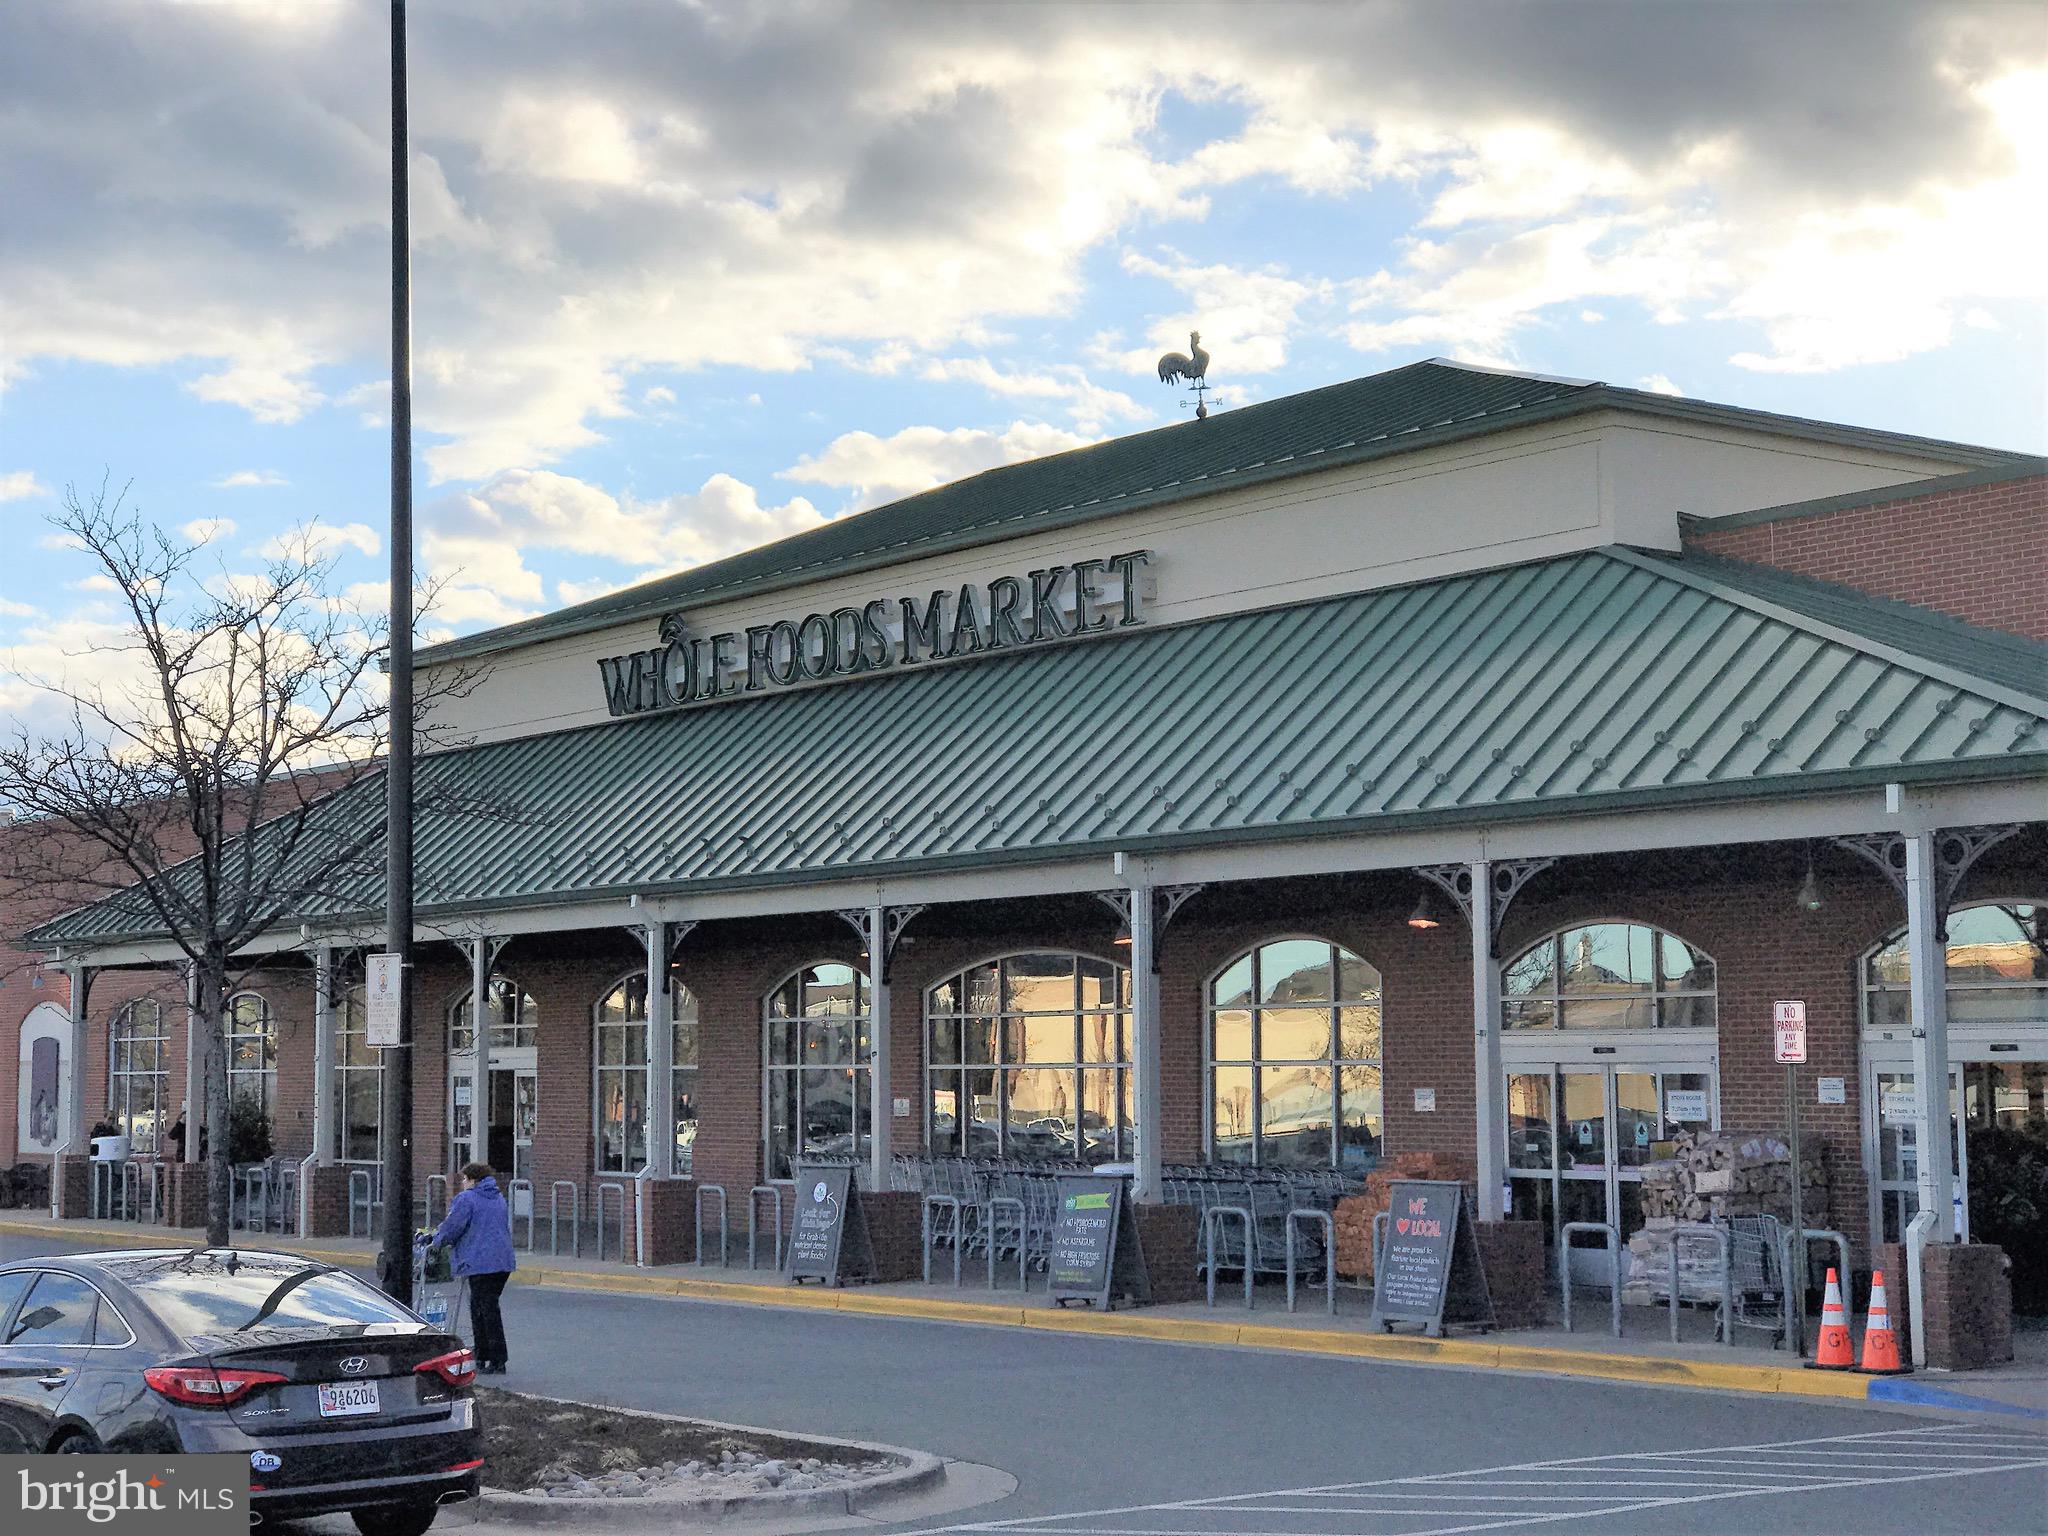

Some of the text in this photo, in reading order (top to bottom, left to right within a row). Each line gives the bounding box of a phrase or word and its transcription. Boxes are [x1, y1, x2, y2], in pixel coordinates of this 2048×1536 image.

[598, 548, 1158, 717] WHOLE FOODS MARKET
[1784, 1007, 1796, 1018] NO
[1777, 1021, 1803, 1032] PARKING
[1785, 1033, 1796, 1041] ANY
[1785, 1042, 1798, 1050] TIME
[1409, 1197, 1428, 1216] WE
[1065, 1218, 1073, 1227] NO
[1411, 1219, 1441, 1237] LOCAL
[1075, 1226, 1087, 1235] FATS
